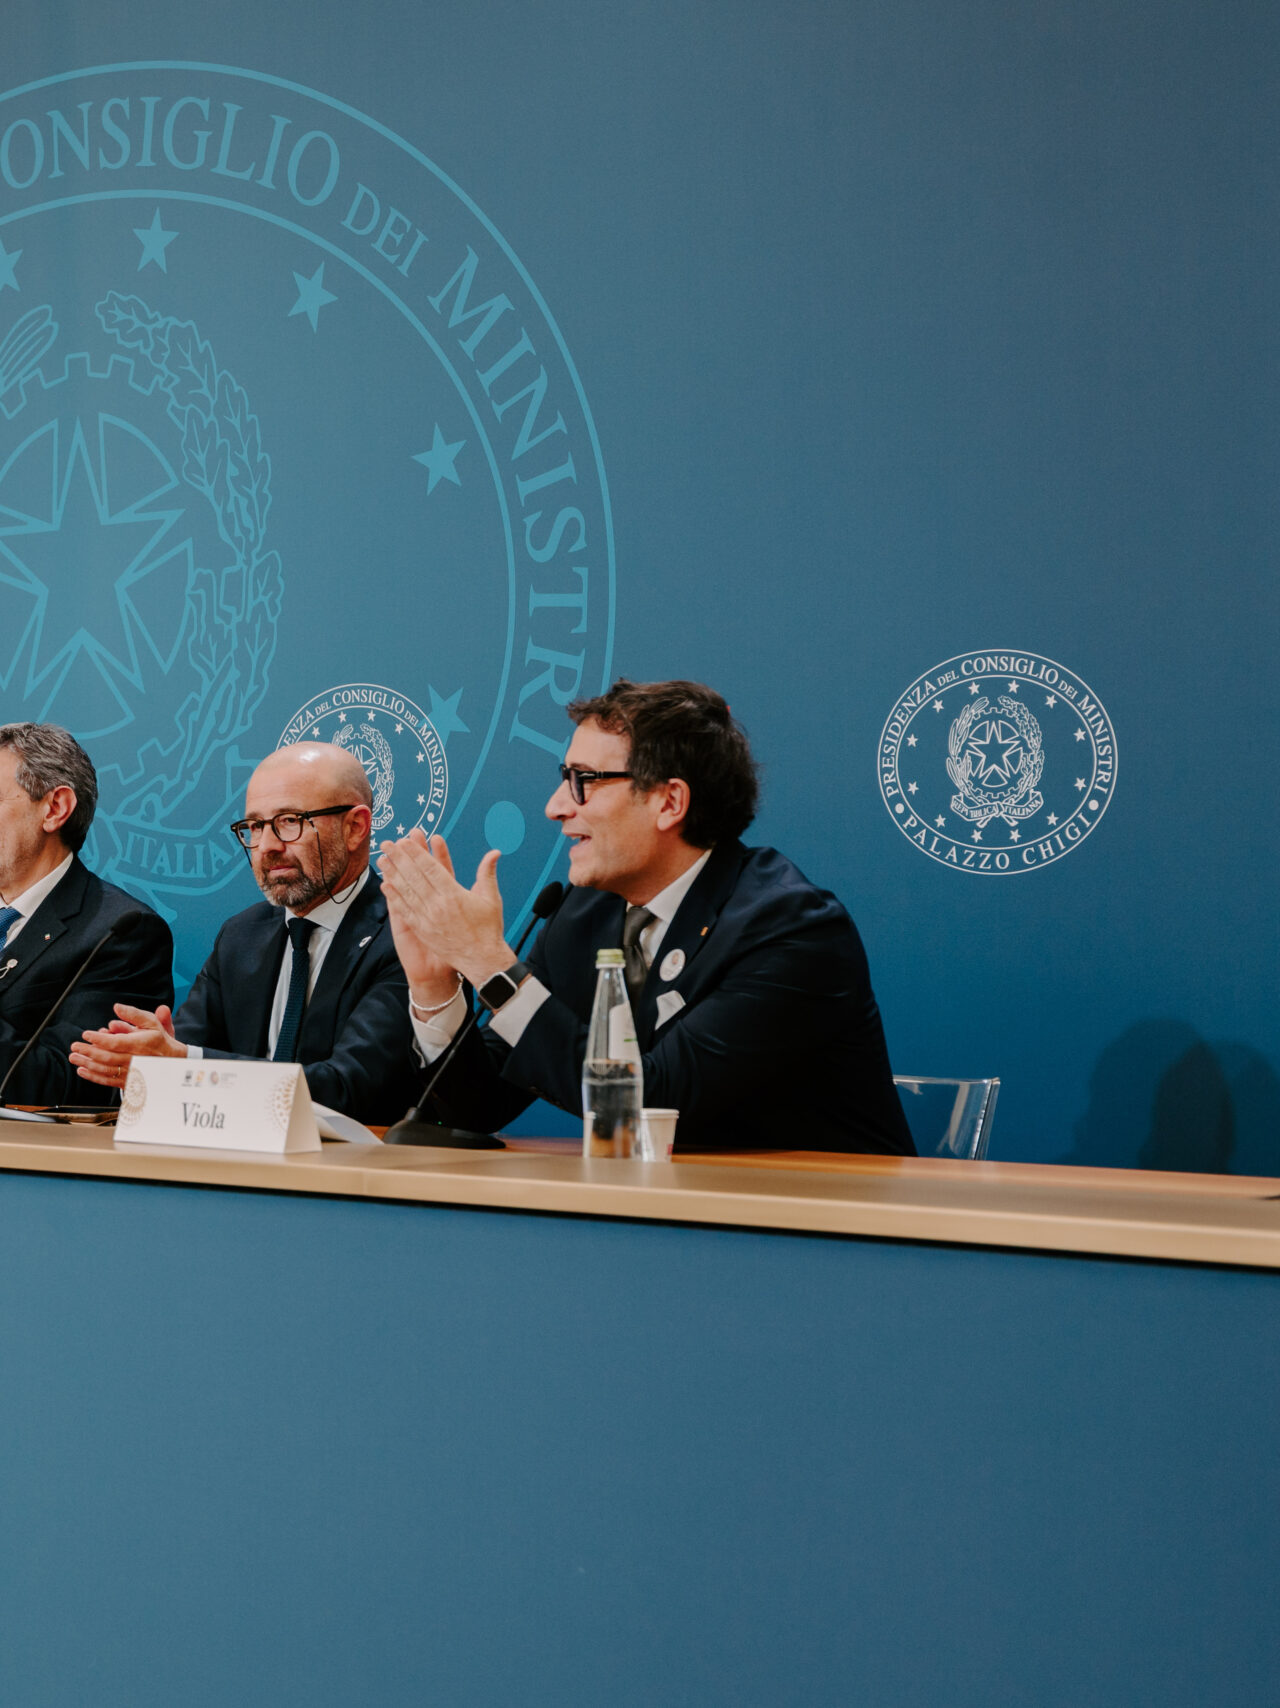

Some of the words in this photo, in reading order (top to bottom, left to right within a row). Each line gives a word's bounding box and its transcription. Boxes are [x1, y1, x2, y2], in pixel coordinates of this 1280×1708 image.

[341, 182, 429, 277] DEI
[427, 245, 589, 764] MINISTRI
[314, 701, 332, 716] DEL
[332, 689, 405, 714] CONSIGLIO
[403, 711, 419, 728] DEI
[418, 723, 445, 808] MINISTRI
[882, 681, 936, 798] PRESIDENZA
[938, 671, 960, 687] DEL
[961, 656, 1059, 686] CONSIGLIO
[1058, 680, 1078, 700] DEI
[1078, 695, 1114, 795] MINISTRI
[120, 824, 243, 878] ITALIA
[903, 814, 1011, 870] PALAZZO
[1022, 813, 1092, 866] CHIGI
[181, 1102, 226, 1129] Viola
